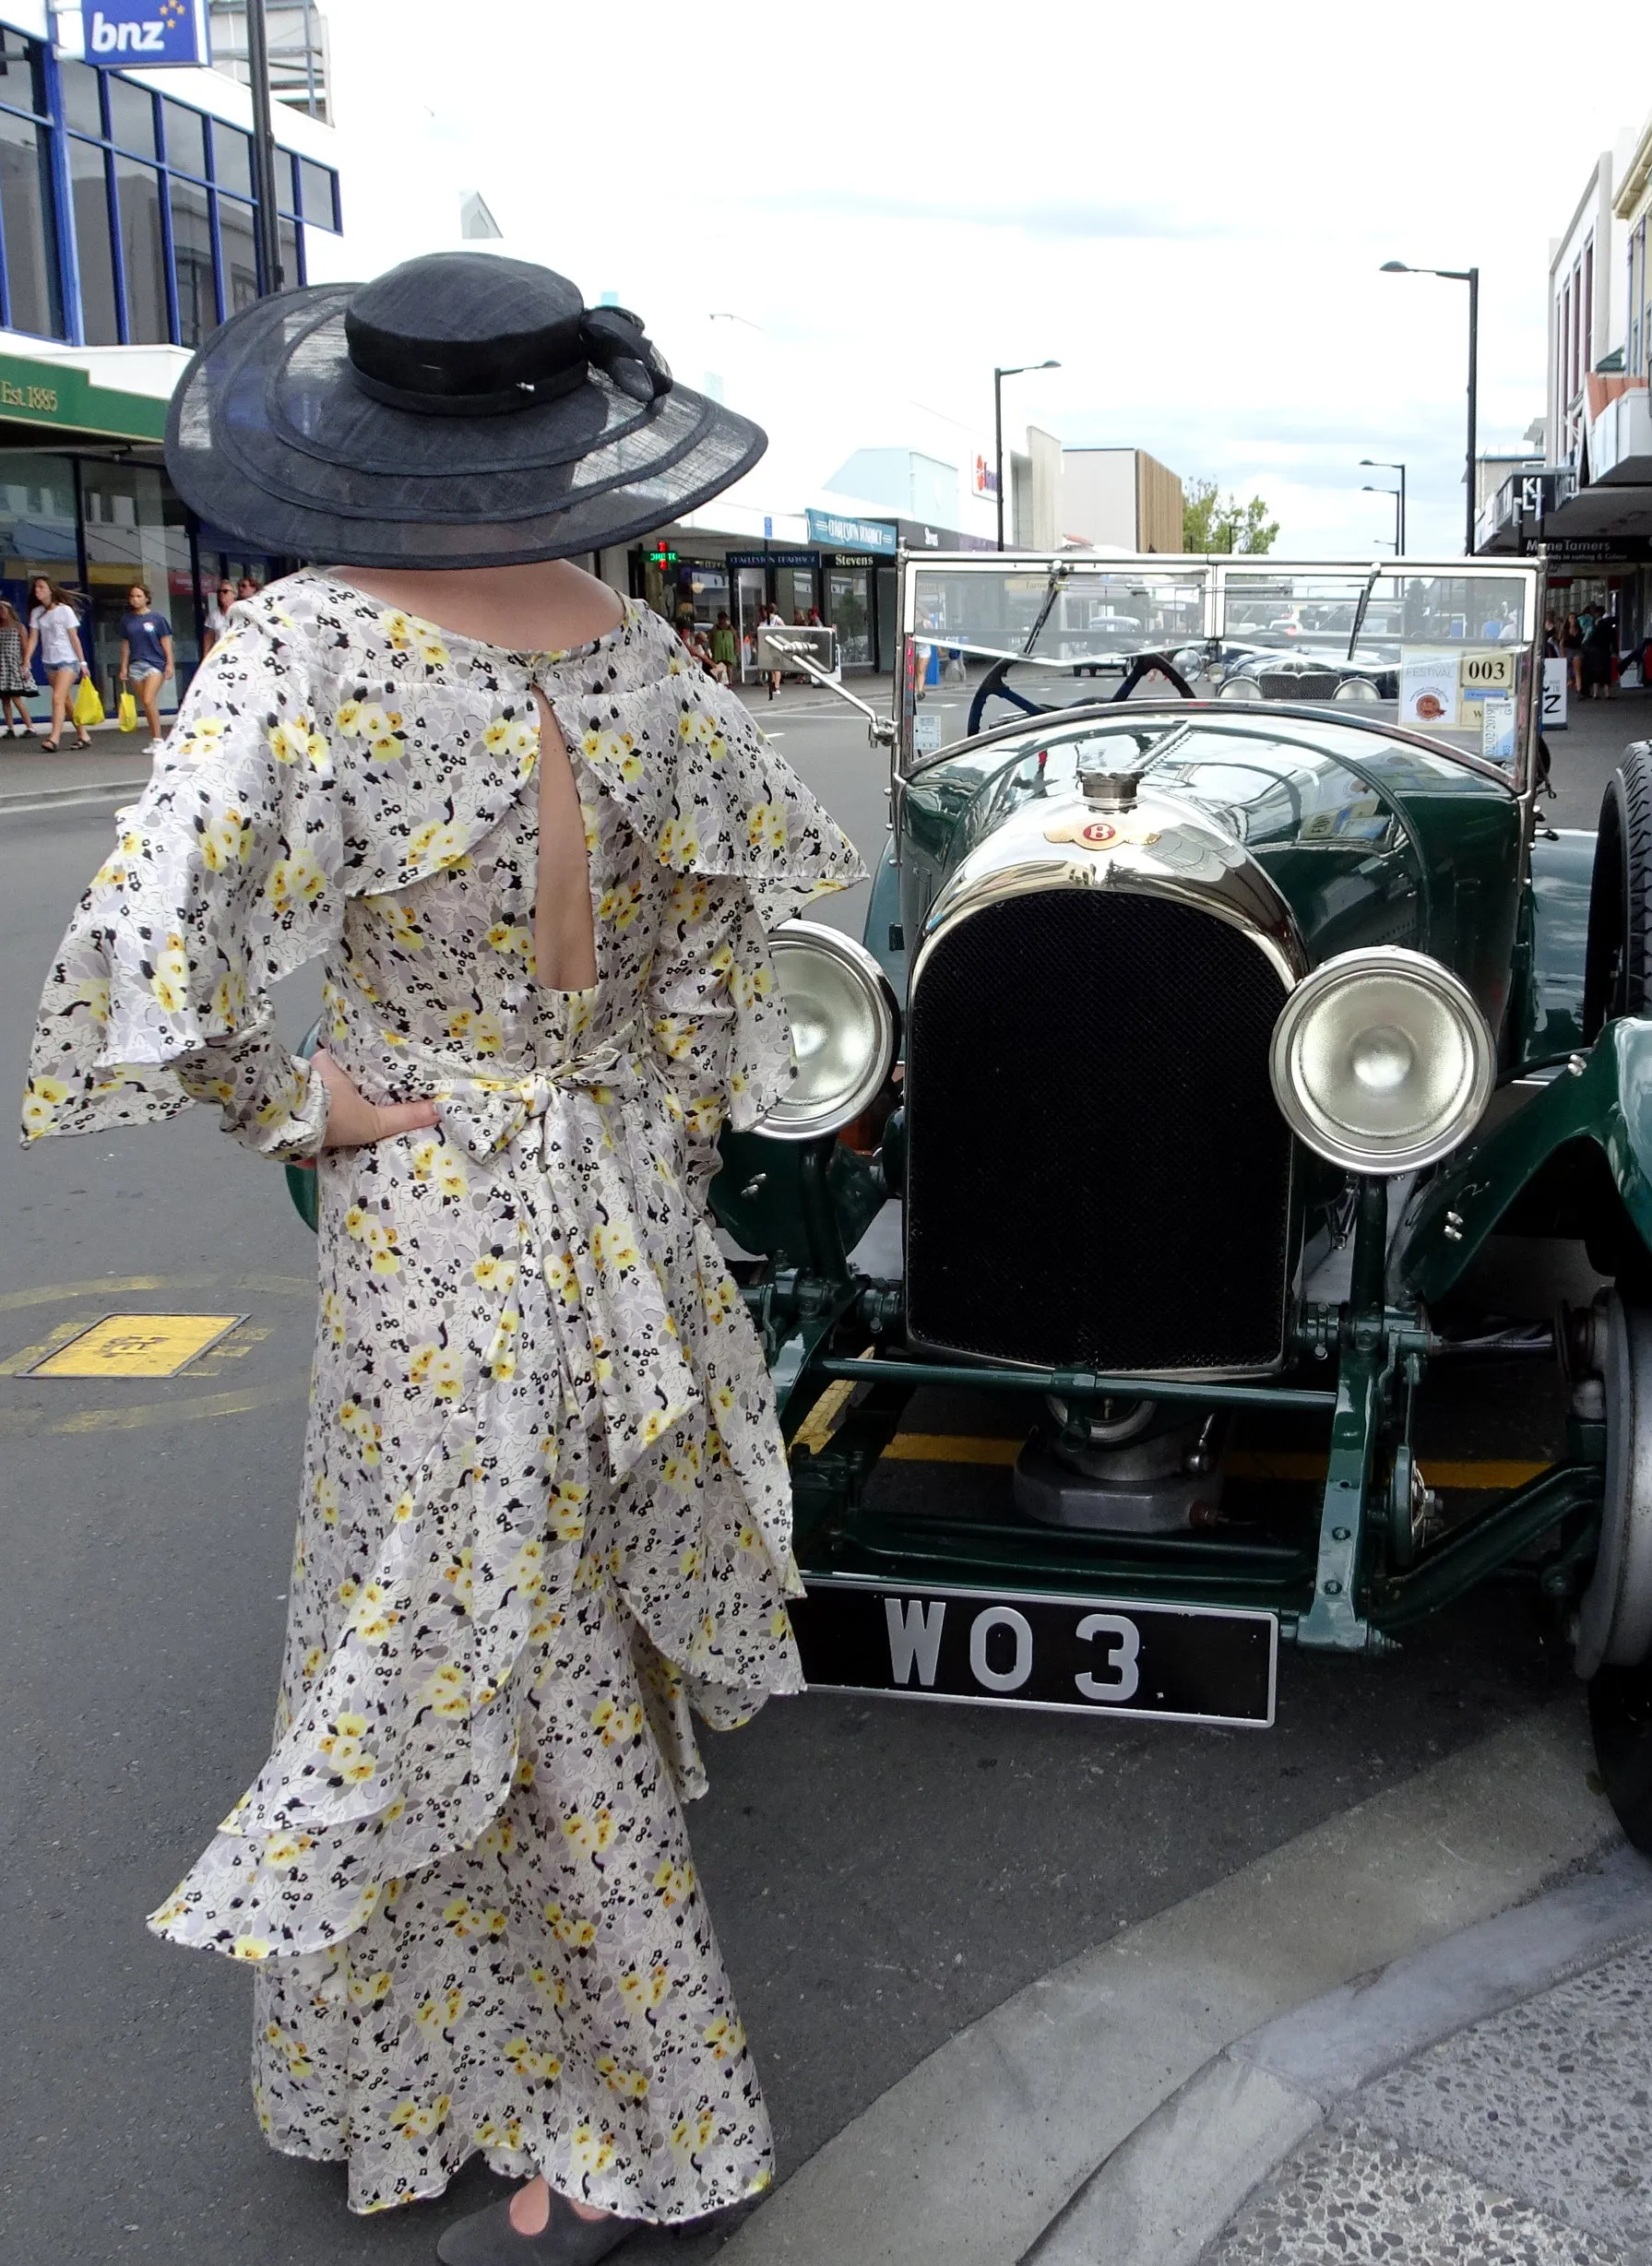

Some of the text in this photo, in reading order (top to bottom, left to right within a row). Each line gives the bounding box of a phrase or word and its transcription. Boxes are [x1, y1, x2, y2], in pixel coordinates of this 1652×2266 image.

[91, 11, 165, 53] bnz
[27, 386, 58, 414] 1885
[835, 554, 874, 566] Stevens
[1468, 660, 1504, 680] 003
